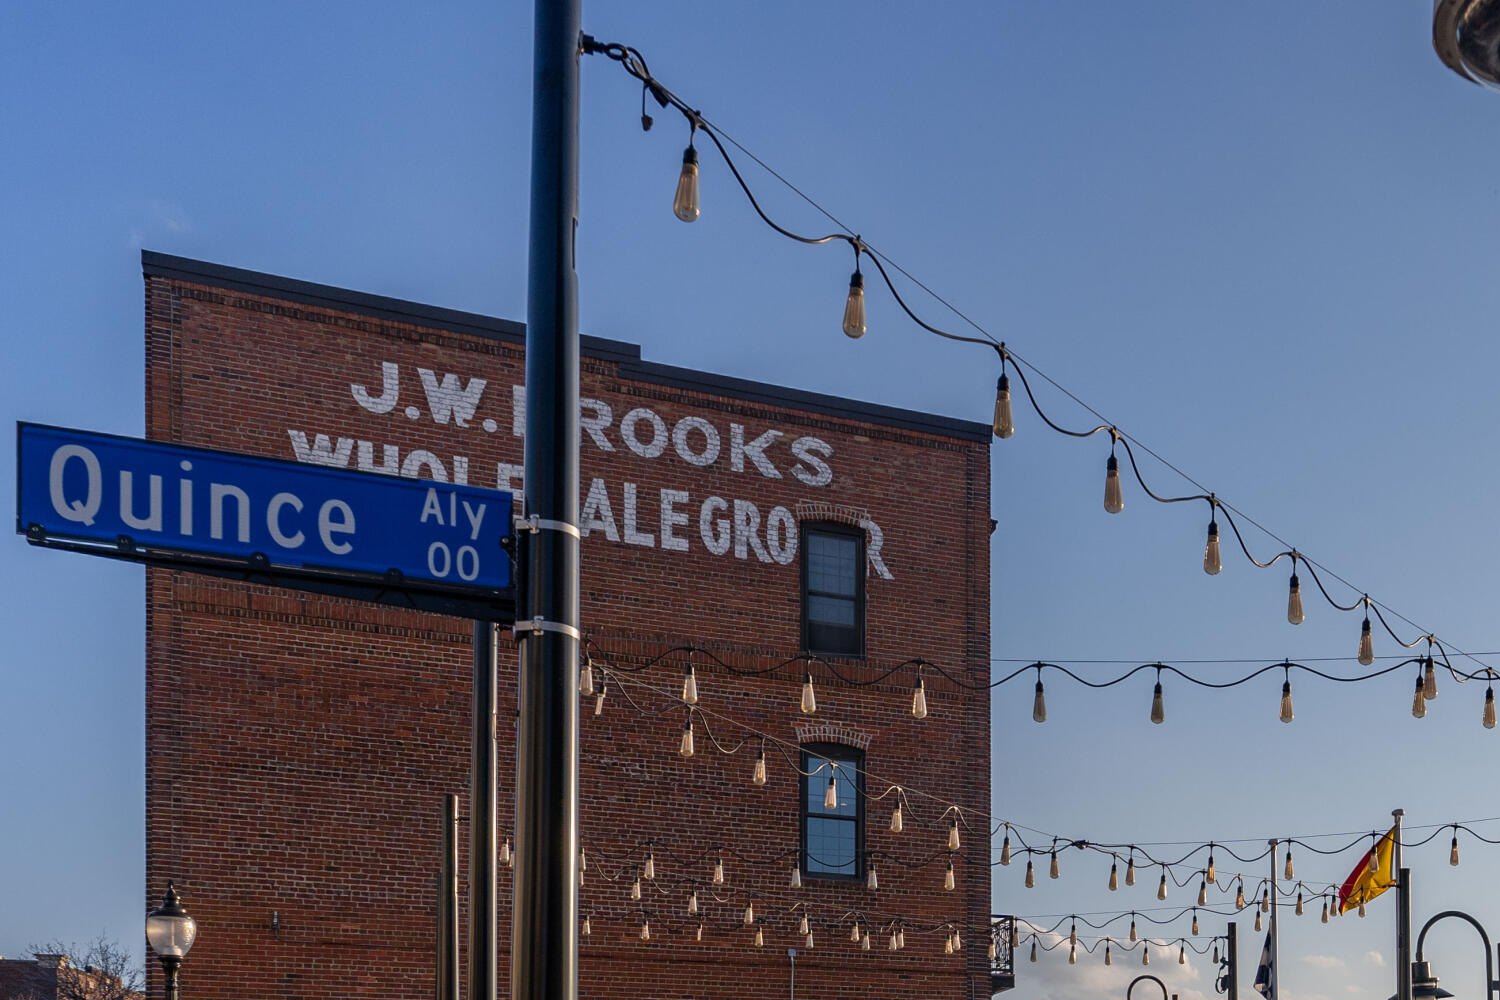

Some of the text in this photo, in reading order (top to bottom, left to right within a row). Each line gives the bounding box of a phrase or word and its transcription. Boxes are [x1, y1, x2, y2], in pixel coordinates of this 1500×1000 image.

[351, 361, 834, 486] J.W. ROOKS
[50, 444, 356, 555] Quince
[420, 487, 487, 541] Aly
[700, 496, 896, 580] GROR
[427, 541, 480, 582] 00
